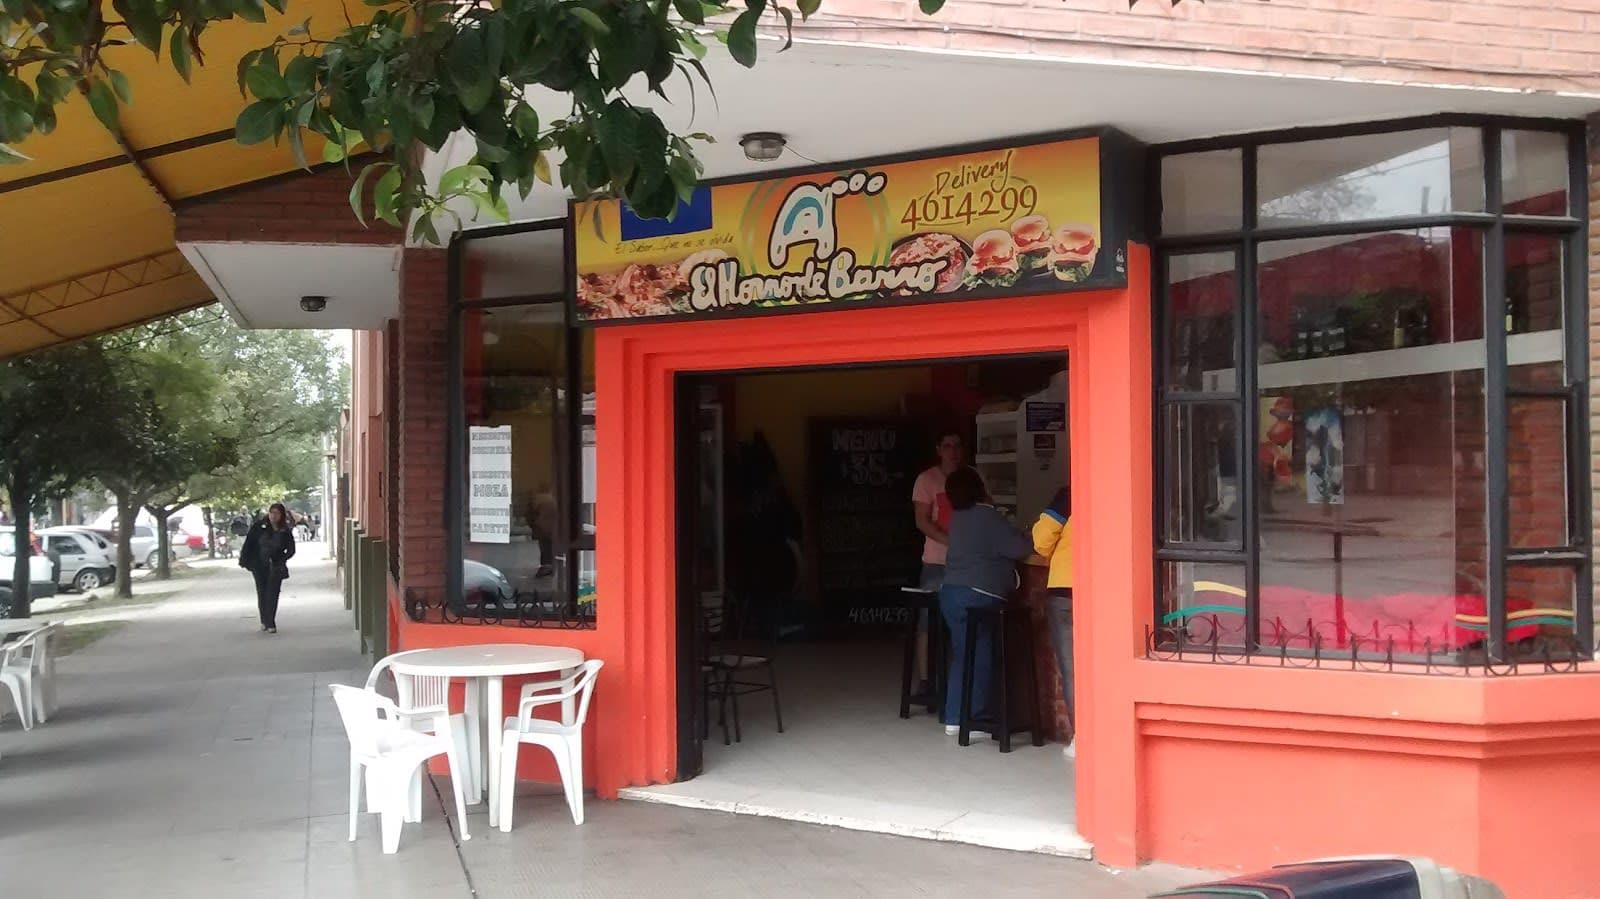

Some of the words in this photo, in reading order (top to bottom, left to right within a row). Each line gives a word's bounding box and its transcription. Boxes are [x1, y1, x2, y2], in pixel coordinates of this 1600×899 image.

[935, 149, 1013, 196] Delivery
[900, 184, 1038, 232] 4614299
[690, 263, 718, 311] El
[827, 249, 948, 300] Barro
[473, 484, 509, 498] MOZA
